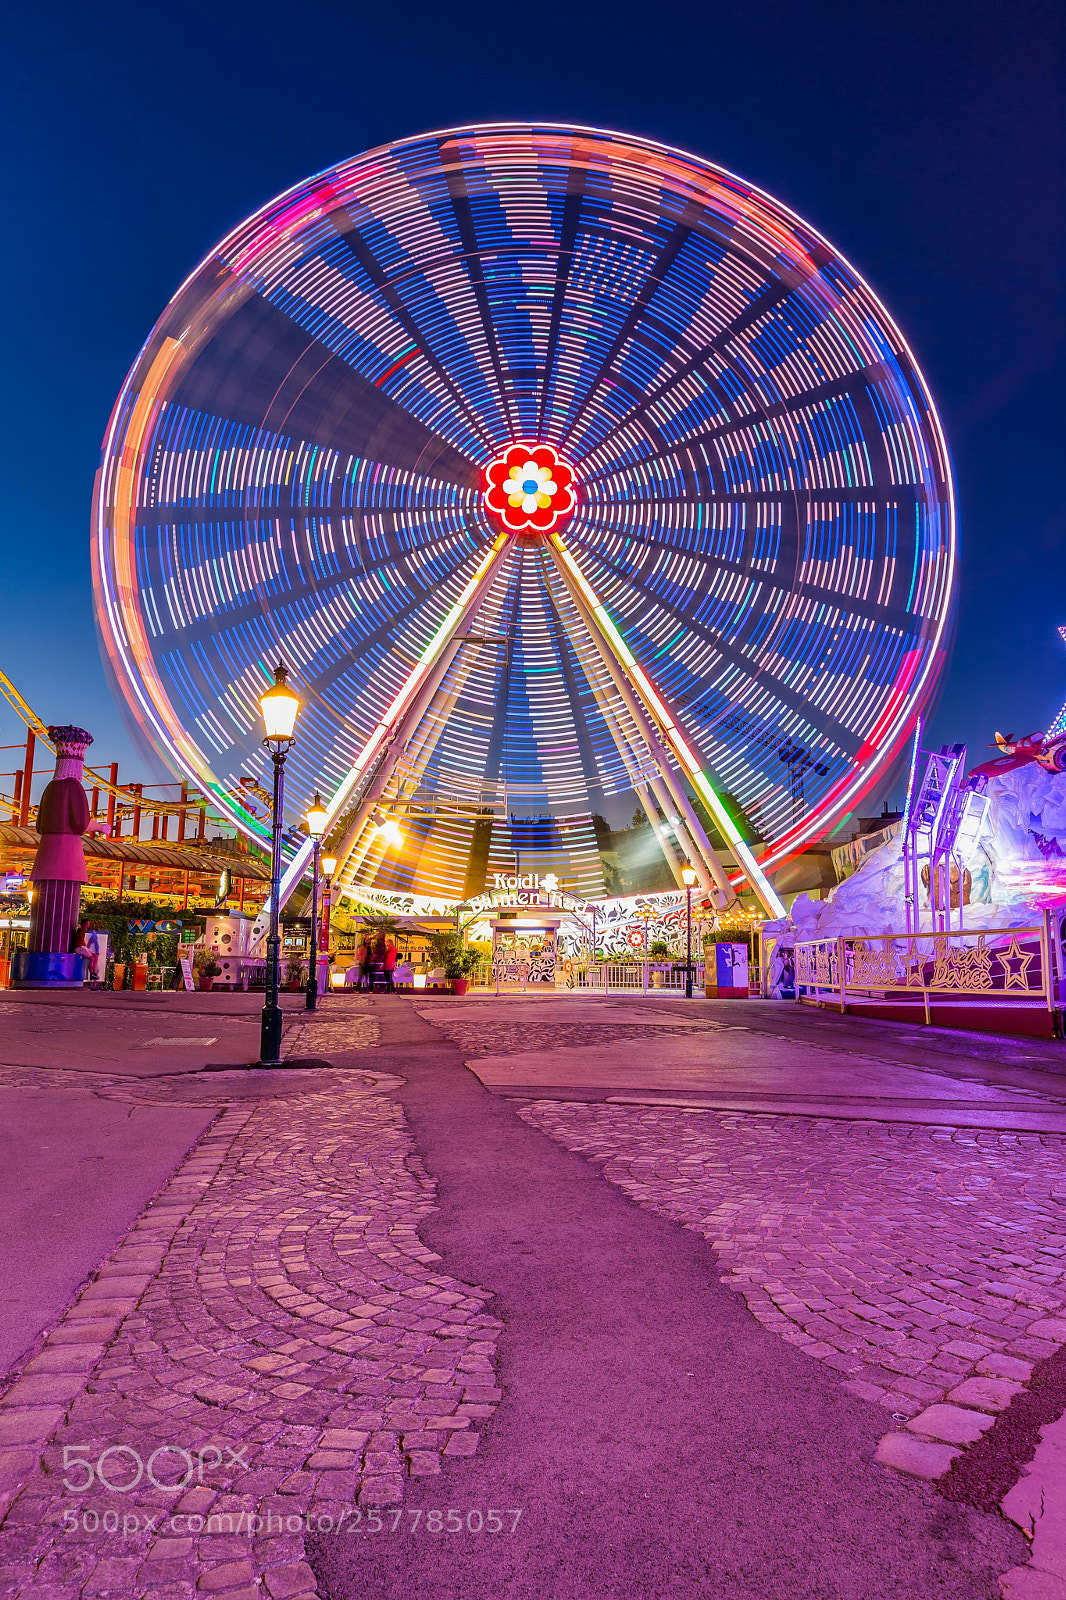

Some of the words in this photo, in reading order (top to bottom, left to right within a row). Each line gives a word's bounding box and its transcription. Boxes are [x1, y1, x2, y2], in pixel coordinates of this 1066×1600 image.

[493, 873, 540, 889] Koidl
[468, 892, 541, 913] Blumen
[550, 891, 588, 914] Rad
[127, 919, 183, 934] WC
[852, 940, 898, 967] Break
[933, 935, 993, 968] Break
[852, 966, 899, 987] Dance
[931, 966, 993, 989] Dance
